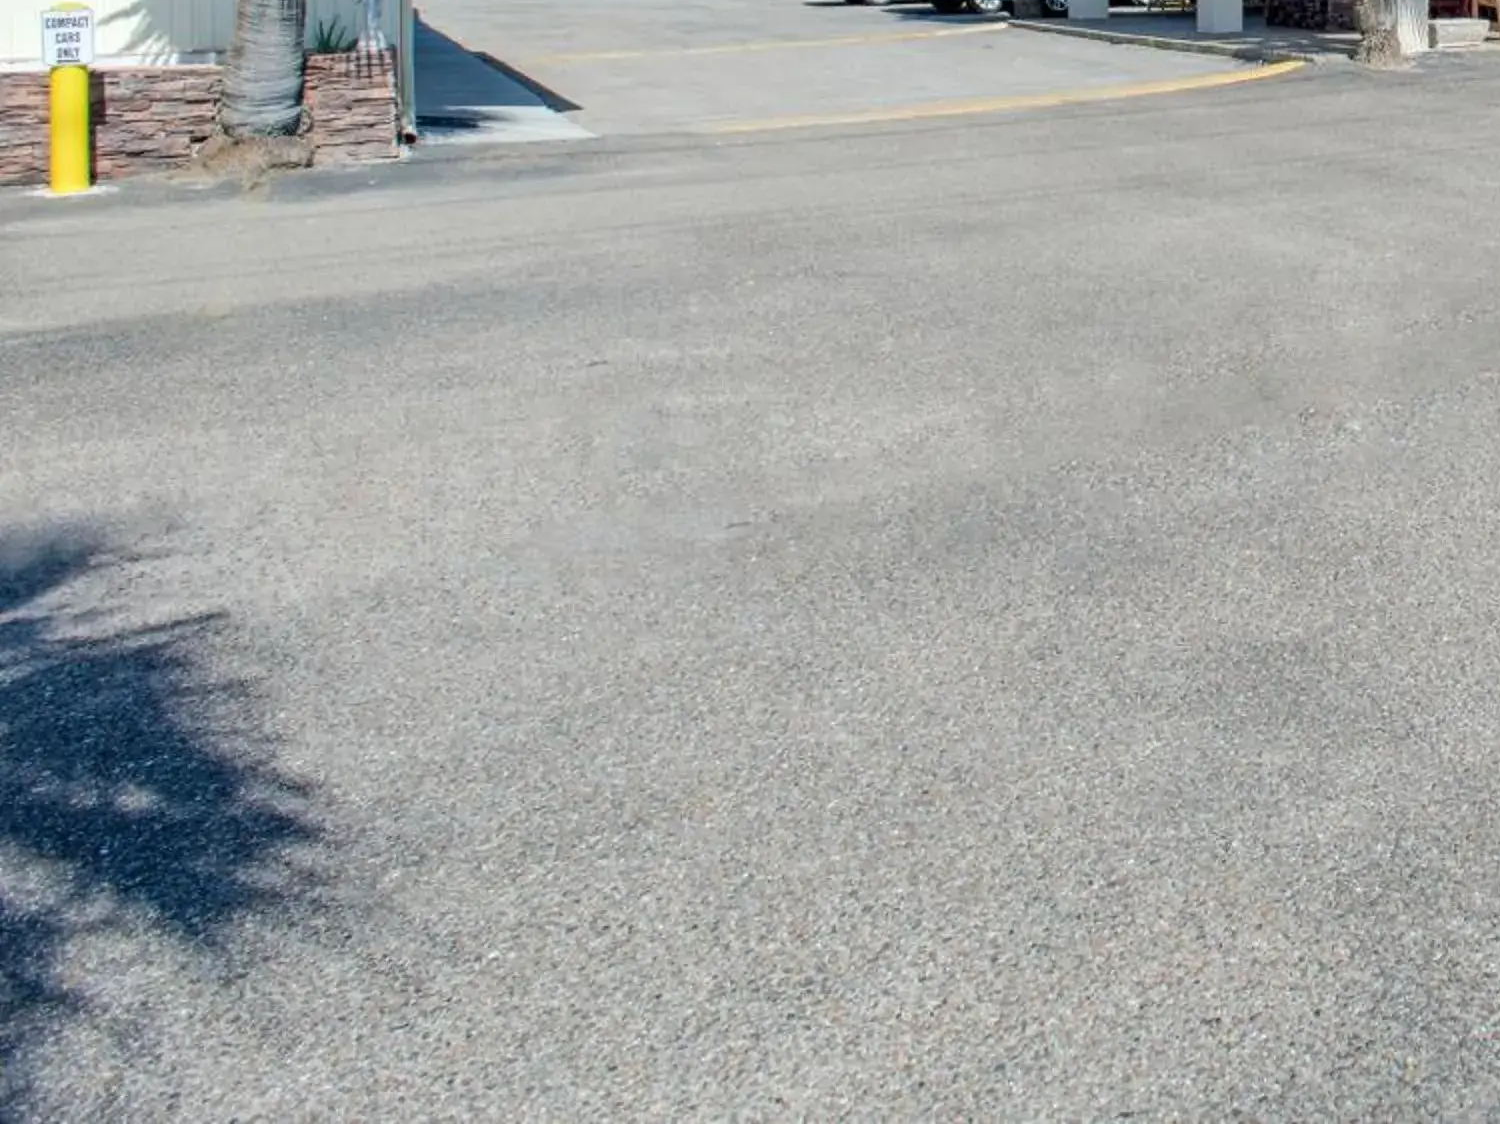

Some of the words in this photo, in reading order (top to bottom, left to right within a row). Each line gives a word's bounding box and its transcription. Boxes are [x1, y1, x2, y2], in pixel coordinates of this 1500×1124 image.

[45, 16, 89, 29] COMPACT
[55, 31, 81, 44] CARS
[56, 47, 80, 58] ONLY
